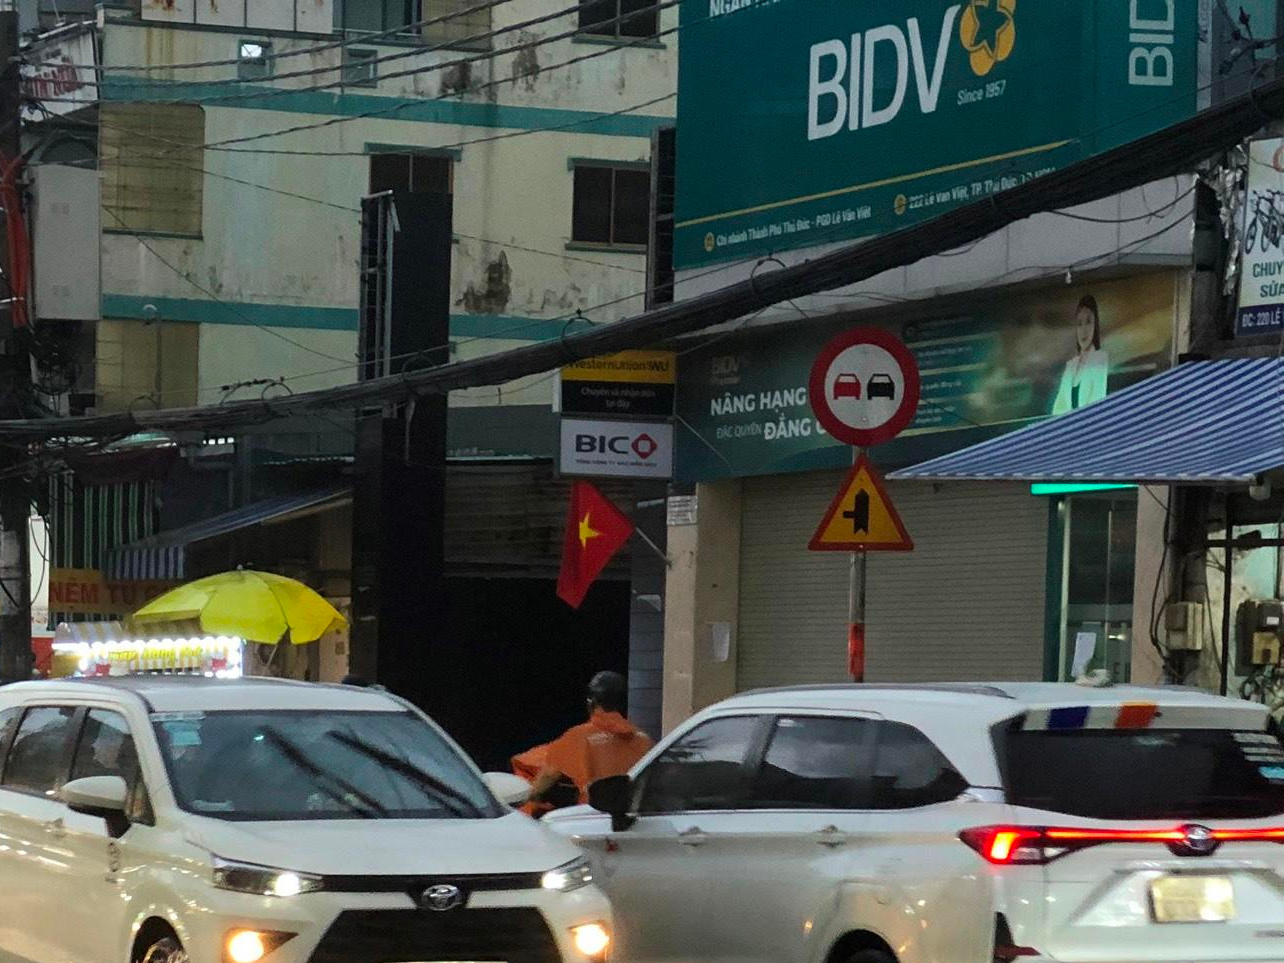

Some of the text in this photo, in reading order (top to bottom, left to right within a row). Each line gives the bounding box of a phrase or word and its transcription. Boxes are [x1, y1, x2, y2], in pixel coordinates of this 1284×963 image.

[808, 4, 961, 140] BIDV
[957, 80, 1007, 105] Since 1957
[710, 386, 807, 416] NÂNG HẠNG
[763, 413, 812, 440] ĐẲNG
[575, 434, 630, 455] BIC
